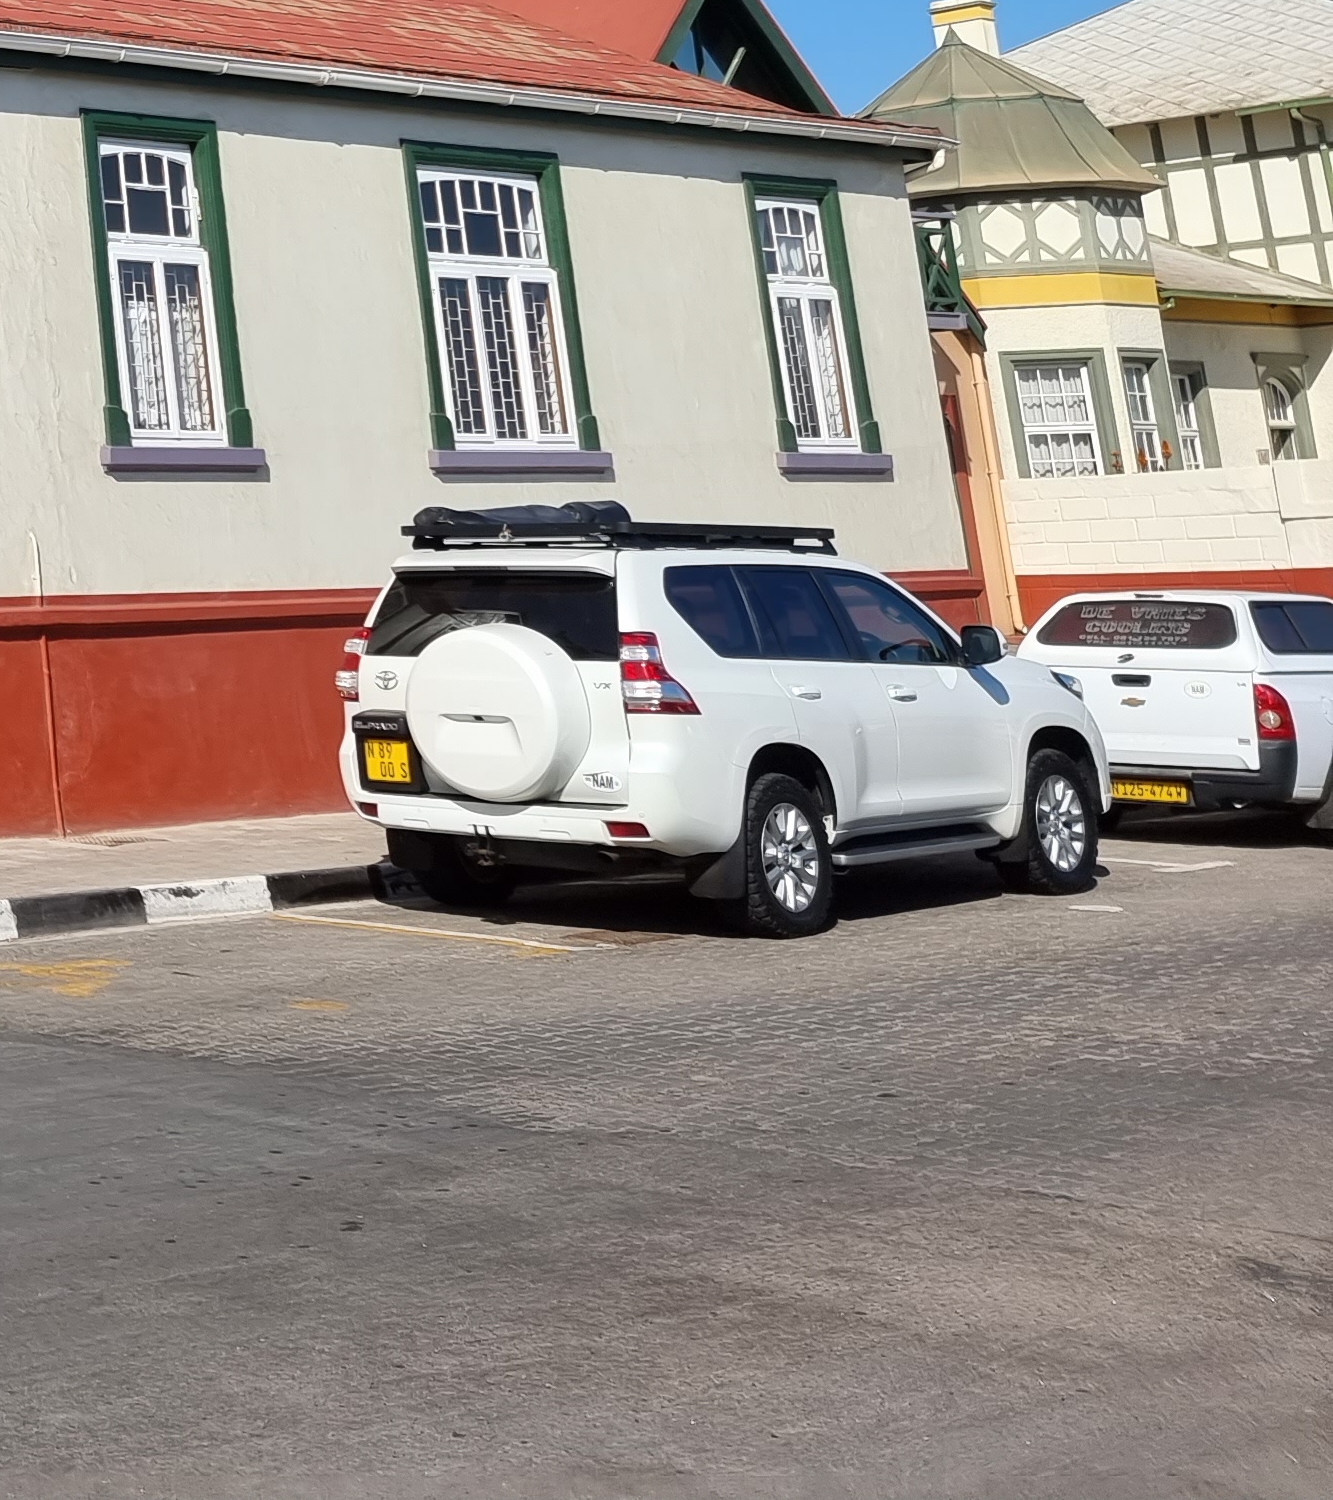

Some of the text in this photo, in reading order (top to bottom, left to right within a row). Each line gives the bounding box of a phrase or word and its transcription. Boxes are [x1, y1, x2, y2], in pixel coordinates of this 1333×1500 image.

[1080, 605, 1206, 620] DE VRIES
[1085, 620, 1191, 634] COOLING
[368, 741, 392, 759] N 89
[380, 761, 408, 779] 00 S
[592, 774, 614, 790] NAM
